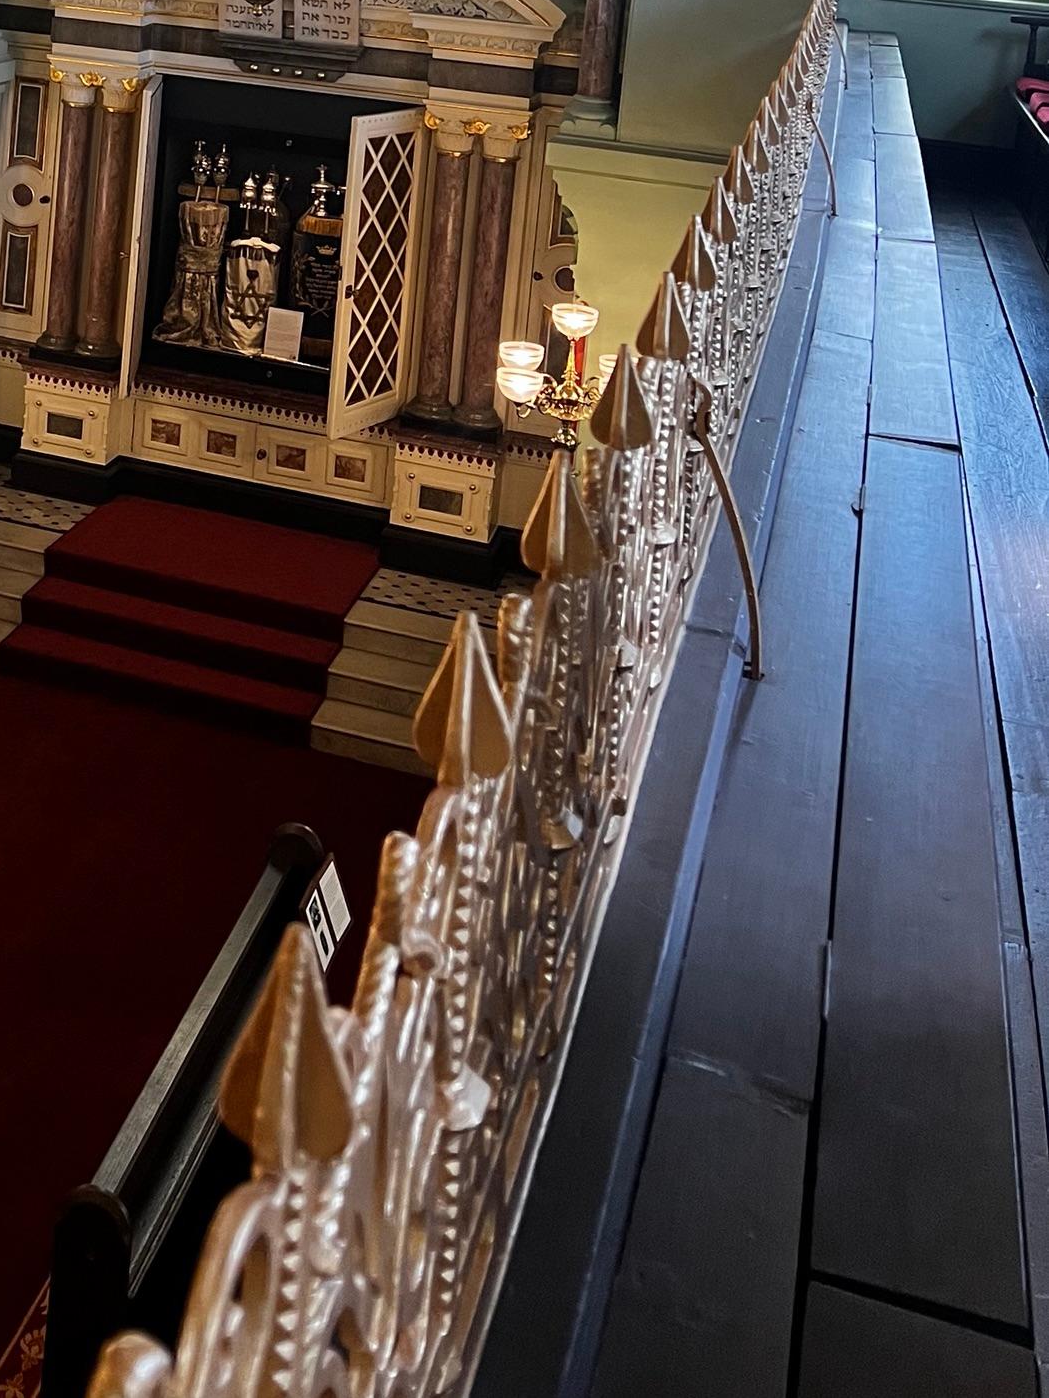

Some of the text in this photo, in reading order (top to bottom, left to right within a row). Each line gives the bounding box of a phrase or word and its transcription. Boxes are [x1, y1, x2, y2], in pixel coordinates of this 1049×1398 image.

[301, 11, 351, 26] זכור את
[301, 26, 350, 40] כבד את
